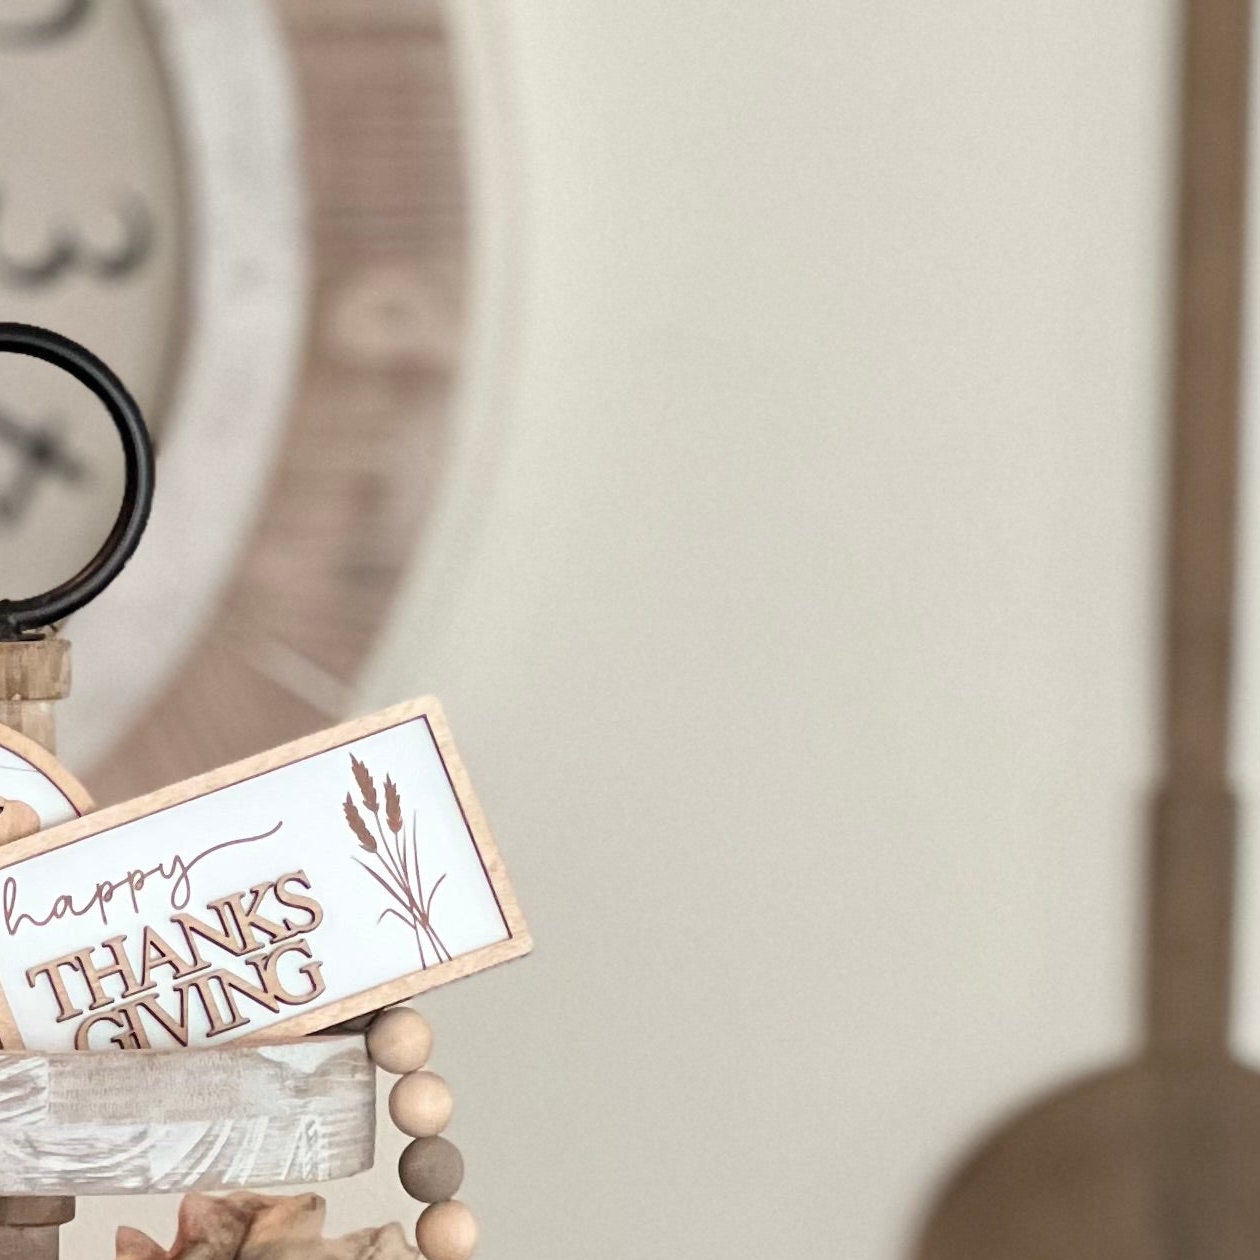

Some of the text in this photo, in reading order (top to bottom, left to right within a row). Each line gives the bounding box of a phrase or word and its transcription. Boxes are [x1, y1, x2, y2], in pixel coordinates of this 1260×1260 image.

[2, 820, 284, 936] happy
[25, 869, 324, 1024] THANKS
[73, 938, 326, 1051] GIVING
